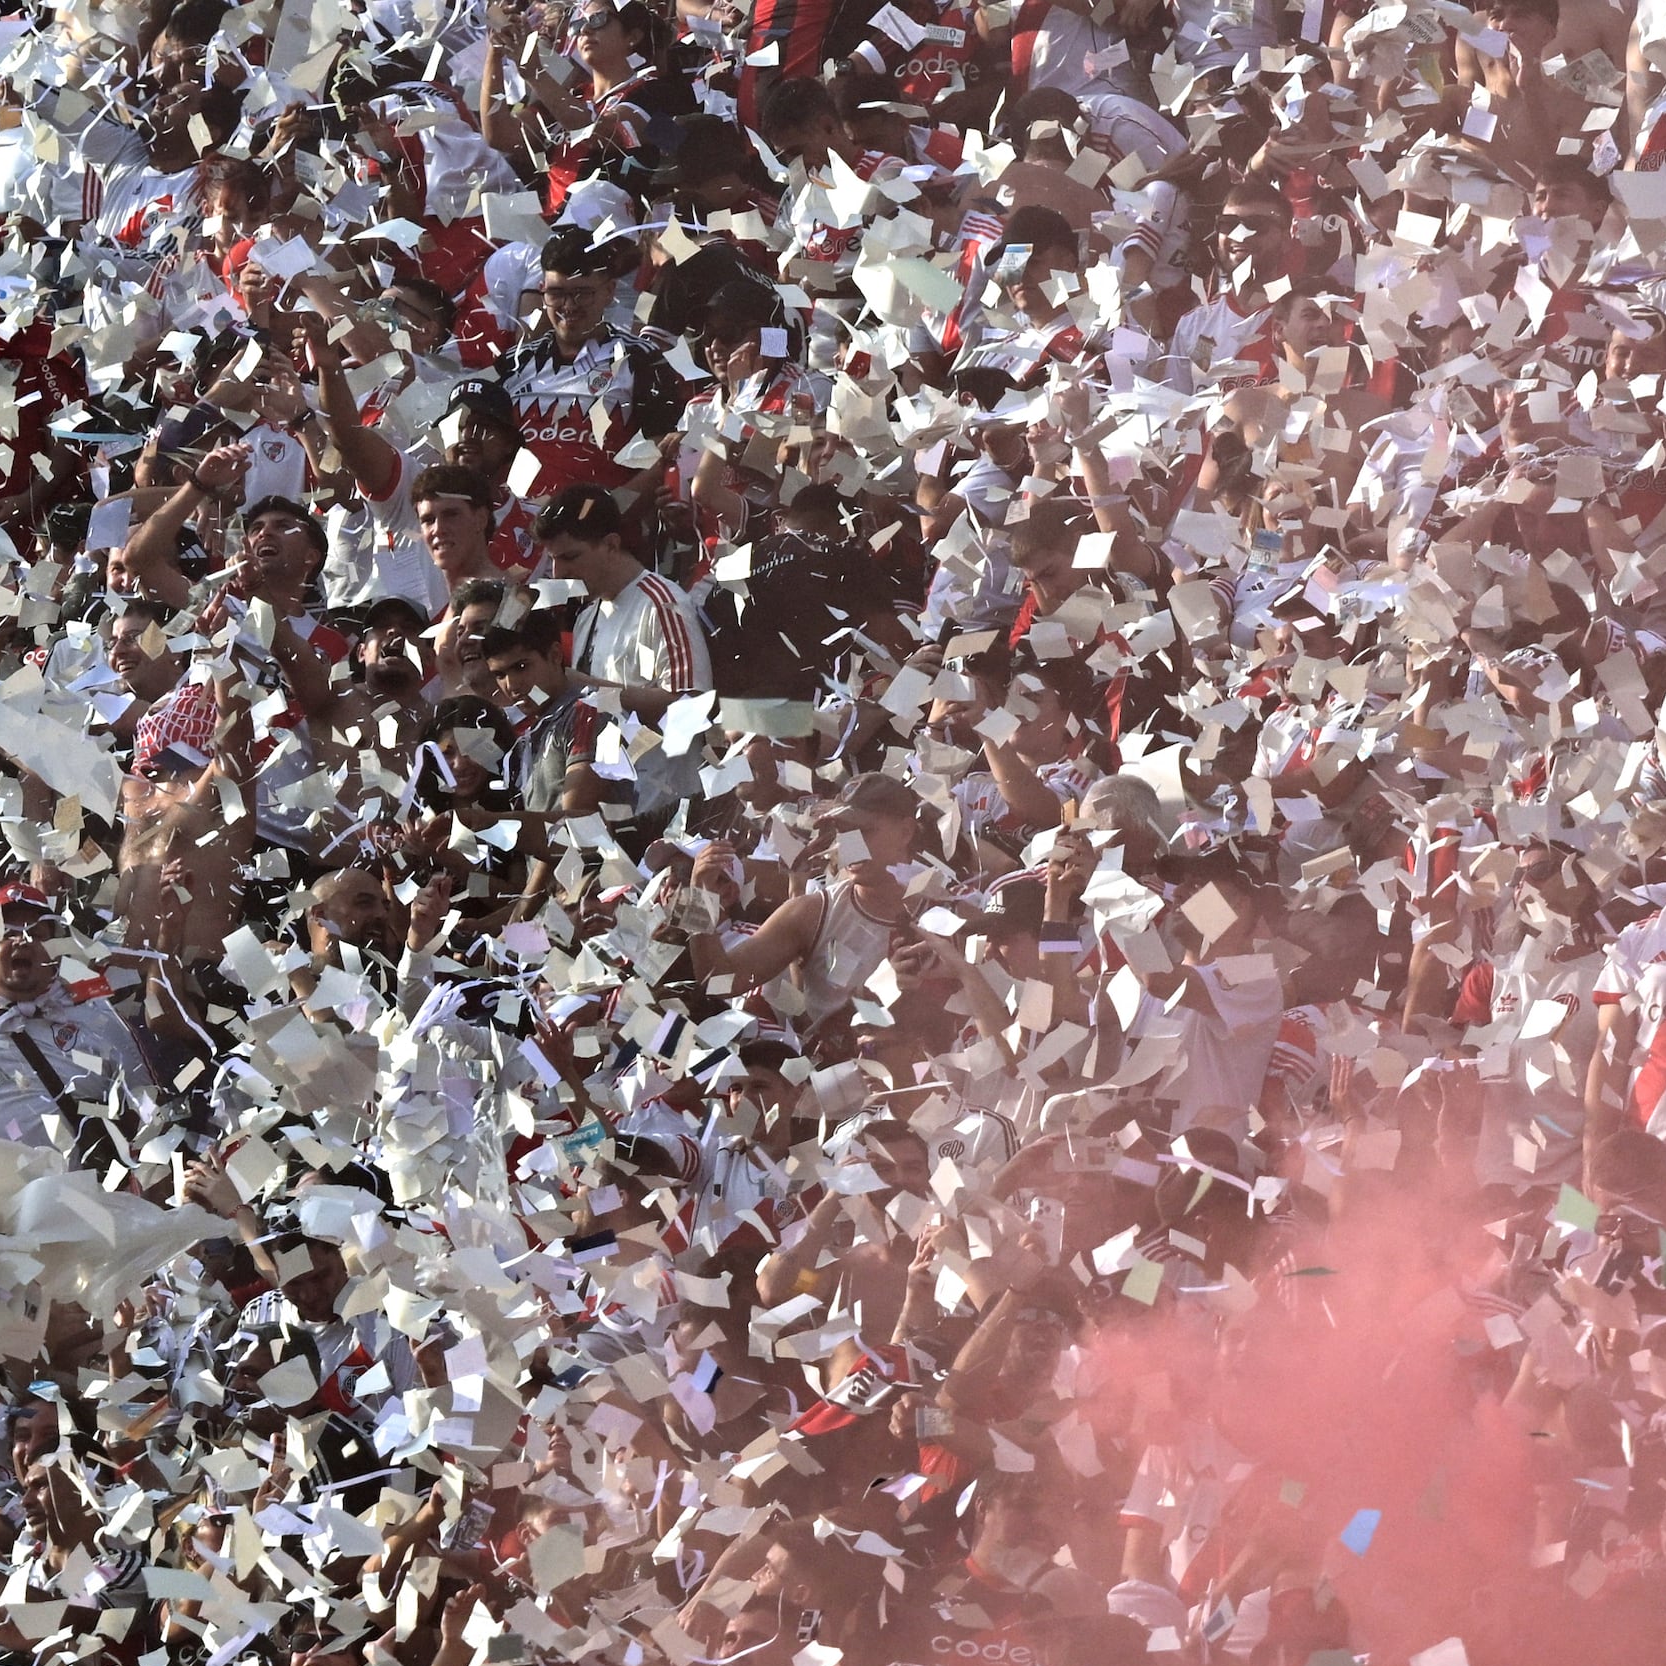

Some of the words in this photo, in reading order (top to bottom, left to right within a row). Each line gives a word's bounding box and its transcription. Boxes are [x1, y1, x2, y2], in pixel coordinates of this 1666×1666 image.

[892, 52, 978, 80] codere
[38, 358, 62, 400] codere
[930, 1634, 1032, 1664] code
